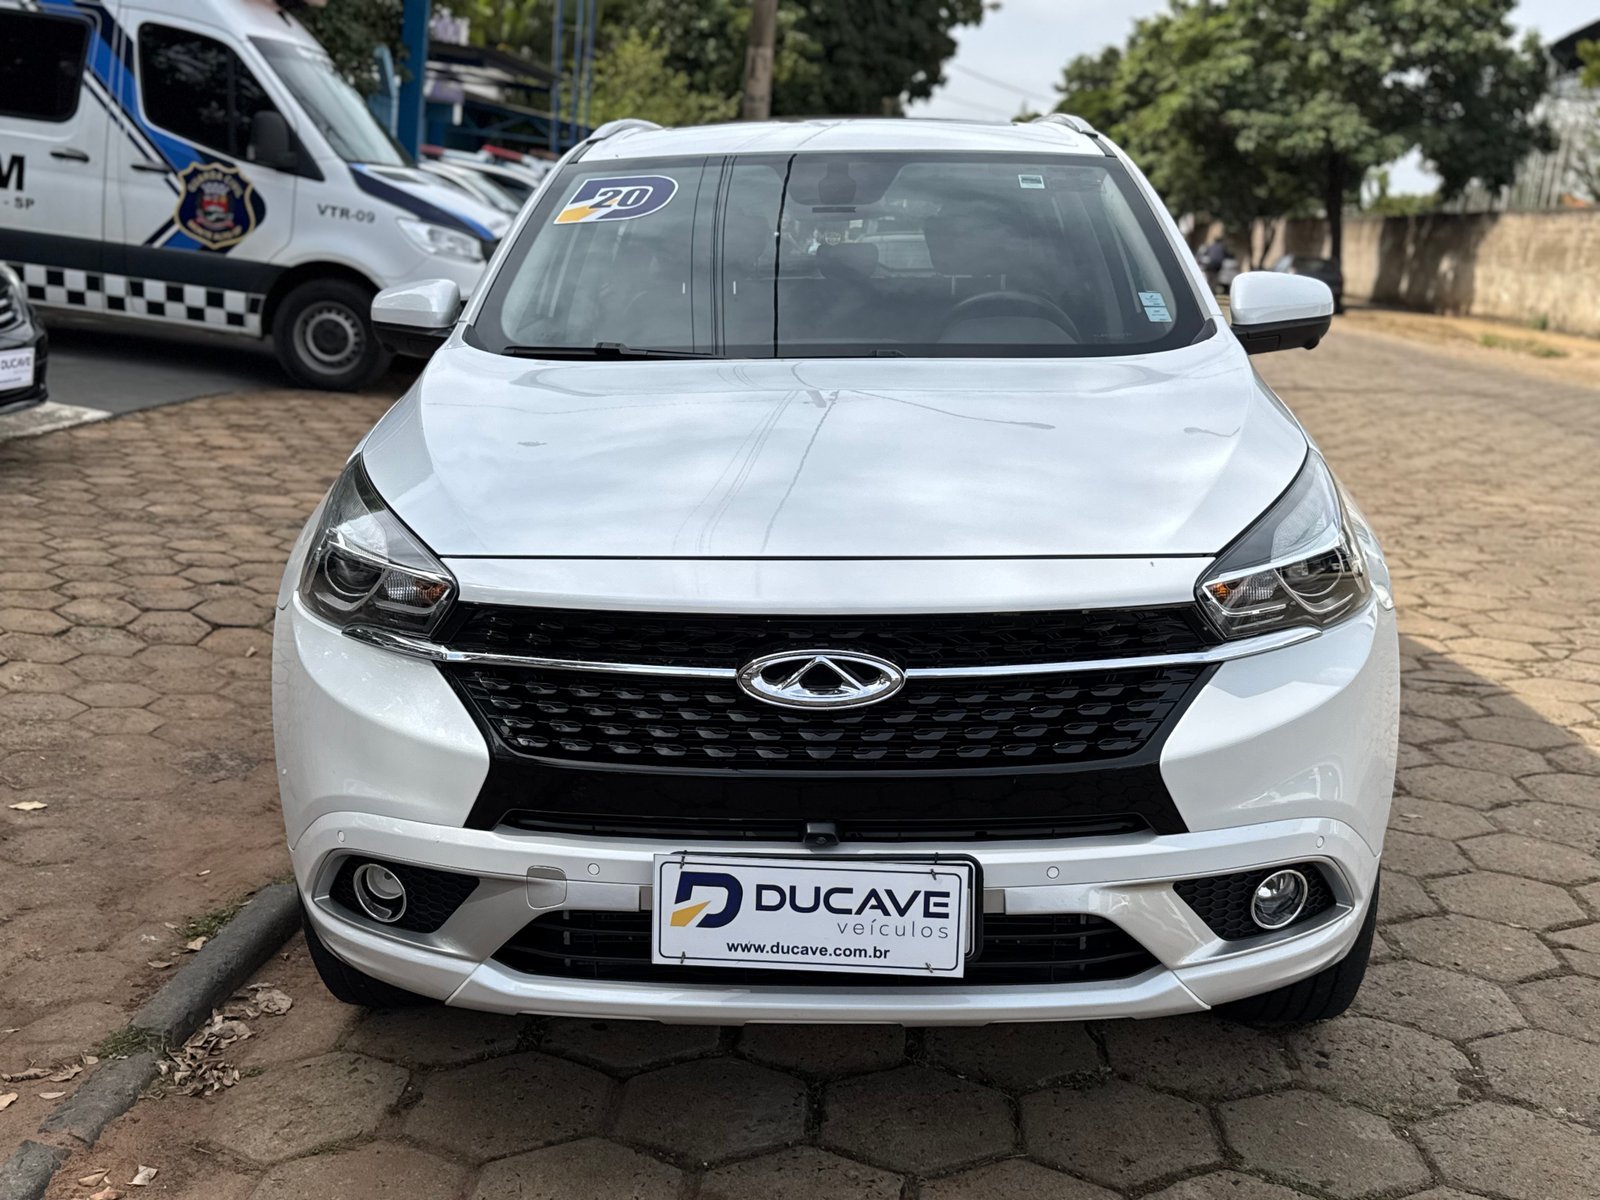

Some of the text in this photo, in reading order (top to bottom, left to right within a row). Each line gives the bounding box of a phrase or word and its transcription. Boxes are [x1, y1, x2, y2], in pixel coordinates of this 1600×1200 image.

[588, 187, 649, 209] 20
[316, 203, 376, 224] VTR-09
[755, 883, 951, 919] DUCAVE
[836, 918, 950, 940] veículos
[726, 940, 891, 960] www.ducave.com.br
